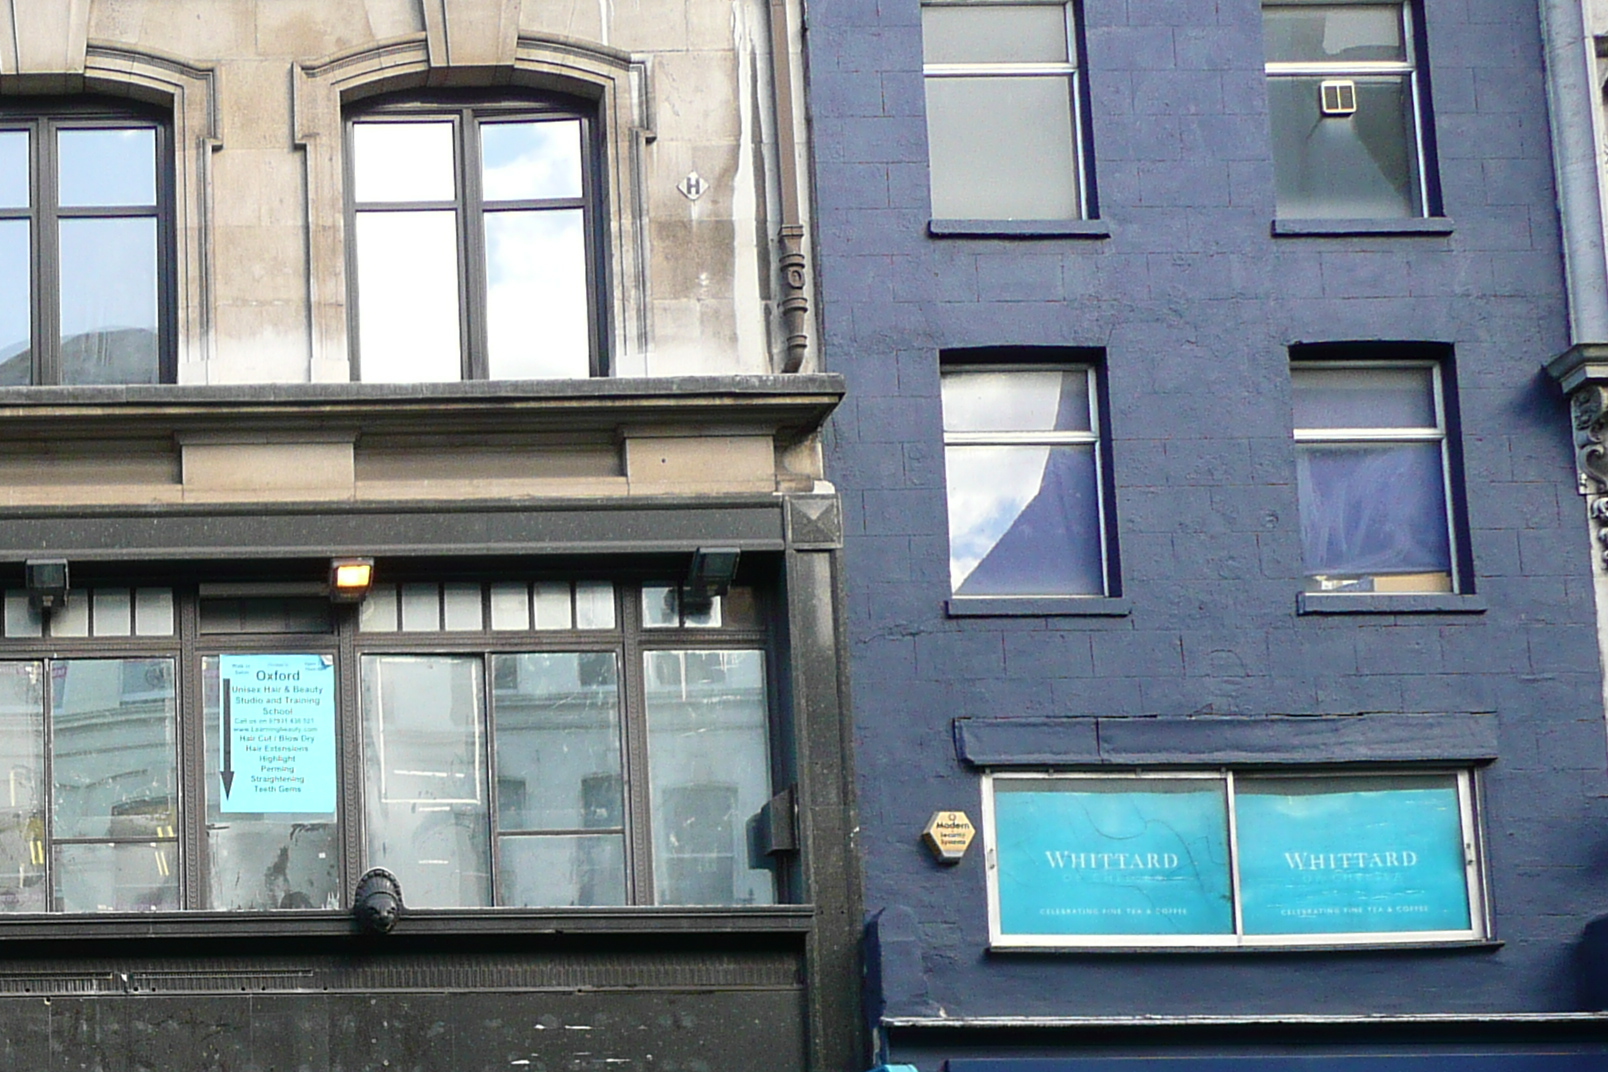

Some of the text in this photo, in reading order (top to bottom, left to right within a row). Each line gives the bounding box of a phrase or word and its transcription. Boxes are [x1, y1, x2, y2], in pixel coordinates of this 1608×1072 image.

[686, 177, 700, 195] H
[256, 670, 301, 681] Oxford
[232, 686, 261, 694] Unisex
[293, 685, 323, 694] Beauty
[266, 696, 282, 704] and
[286, 696, 320, 706] Training
[263, 707, 293, 715] School
[259, 755, 296, 763] Highlight
[261, 765, 295, 774] Perming
[251, 775, 304, 784] Straightening
[936, 822, 970, 830] Modern
[1045, 851, 1179, 869] WHITTARD
[1284, 851, 1418, 870] WHITTARD
[1281, 908, 1340, 917] CELEBRATING
[1396, 905, 1428, 913] COFFEE
